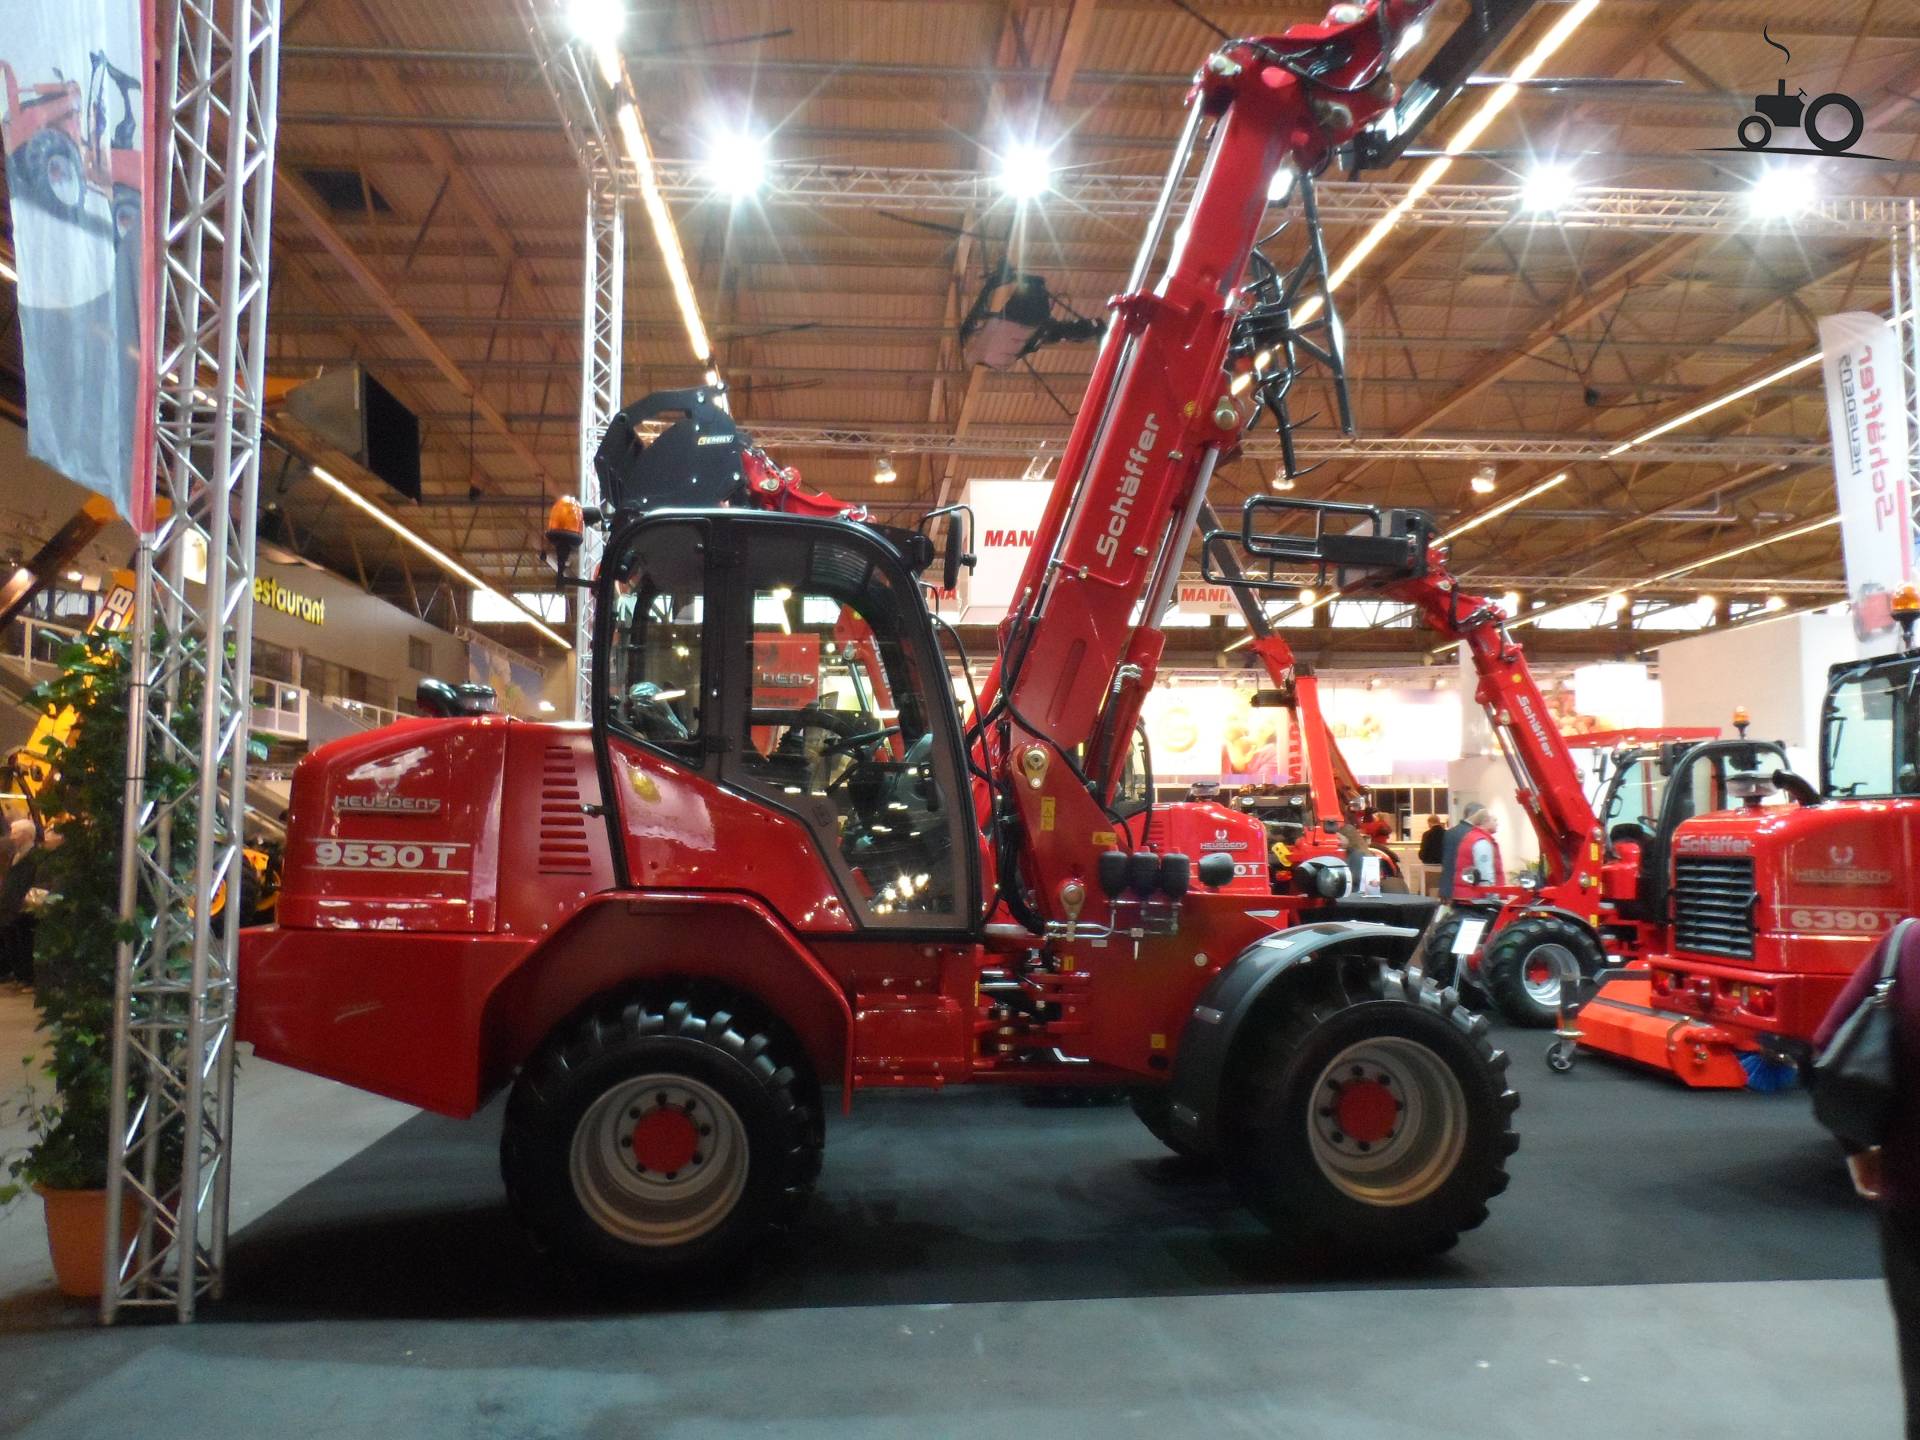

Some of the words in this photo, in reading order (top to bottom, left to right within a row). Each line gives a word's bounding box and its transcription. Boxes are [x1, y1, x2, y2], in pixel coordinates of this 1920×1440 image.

[1096, 413, 1160, 567] Schäffer
[984, 530, 1035, 547] MAN
[254, 576, 325, 625] estaurant
[1182, 588, 1232, 601] MANI
[97, 587, 134, 632] CB
[335, 795, 441, 811] HEUSDENS
[315, 843, 424, 869] 9530
[432, 847, 456, 869] T
[1791, 910, 1879, 930] 6390
